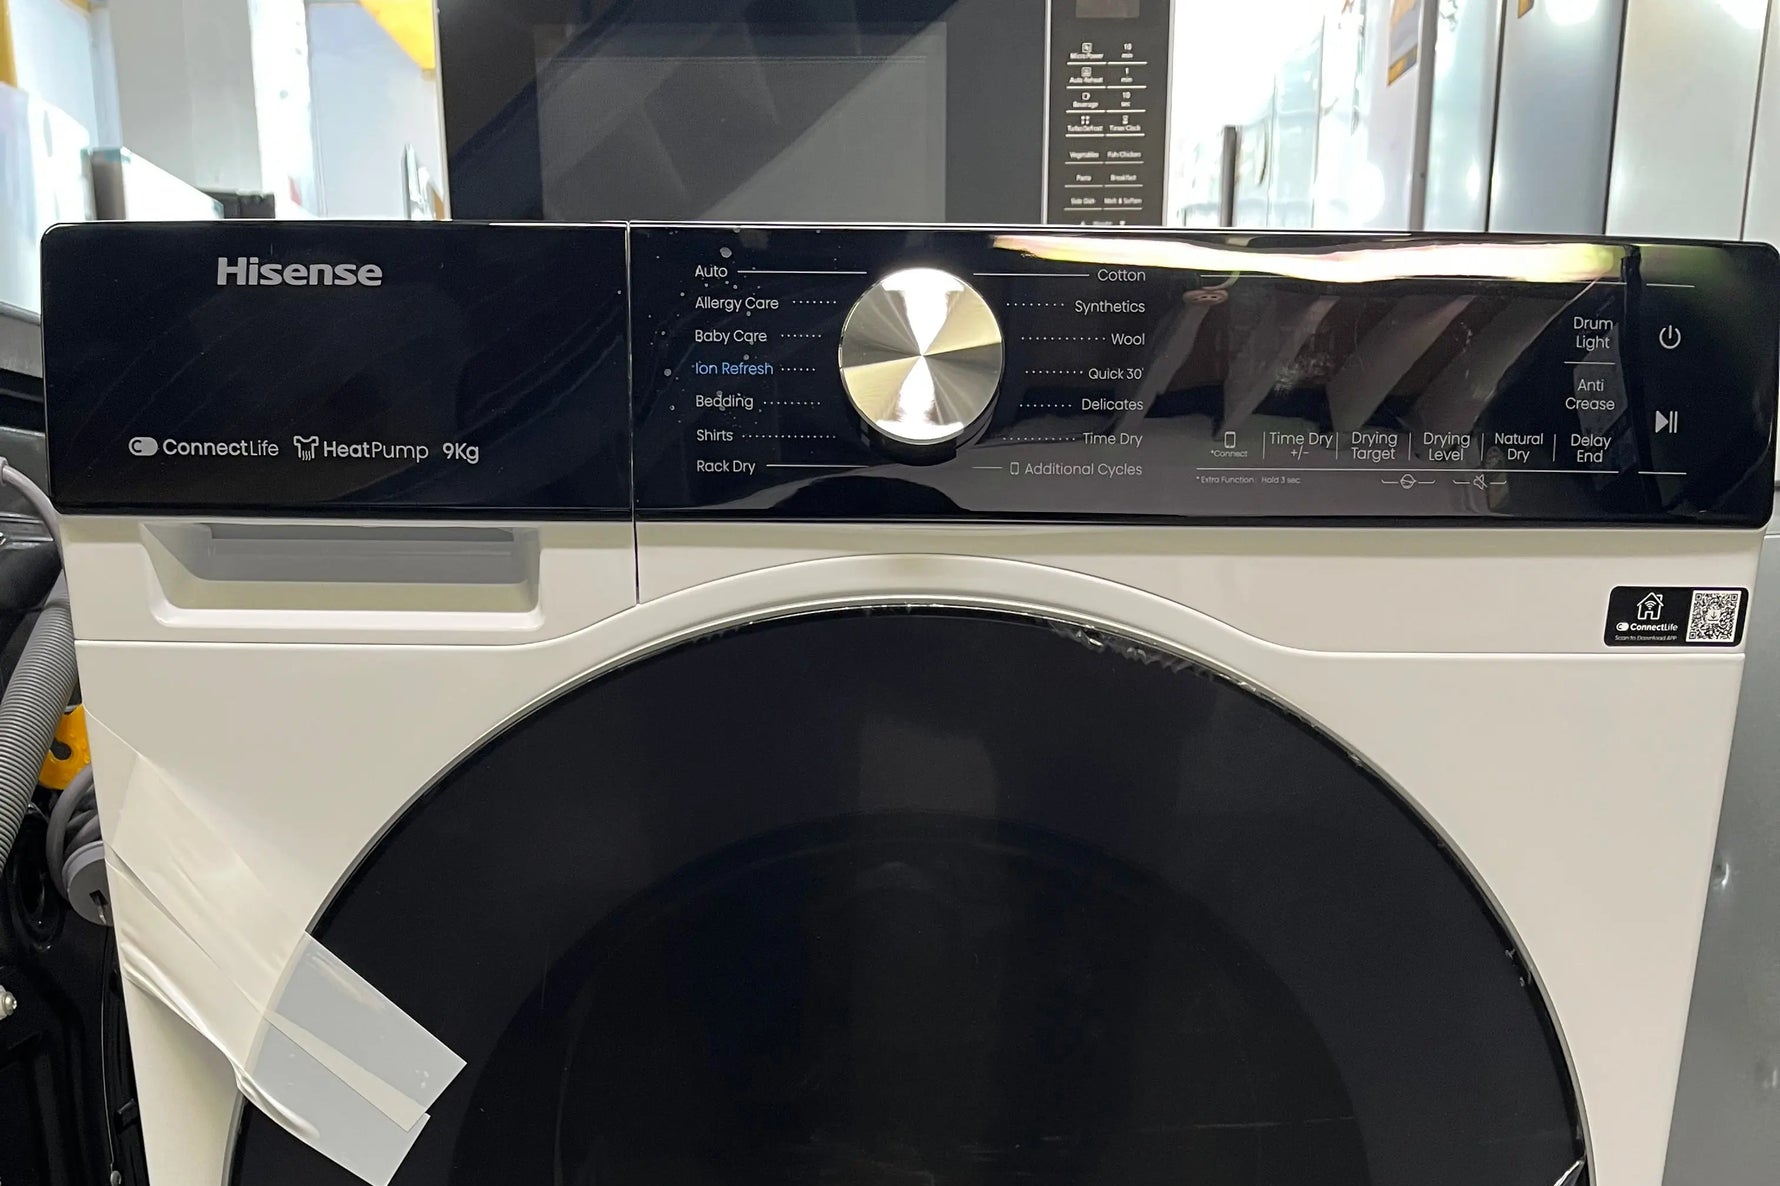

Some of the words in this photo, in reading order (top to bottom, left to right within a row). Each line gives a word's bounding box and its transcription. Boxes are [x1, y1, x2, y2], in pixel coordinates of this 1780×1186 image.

[216, 257, 383, 287] Hisense
[695, 265, 728, 278] Auto
[1097, 269, 1146, 282] Cotton
[695, 297, 743, 312] Allergy
[745, 297, 779, 310] Care
[1075, 300, 1146, 315] Synthetics
[1573, 316, 1613, 330] Drum
[695, 330, 731, 345] Baby
[733, 330, 767, 342] Care
[1111, 333, 1145, 345] Wool
[1576, 335, 1610, 351] Light
[695, 362, 718, 375] Ion
[722, 362, 774, 375] Refresh
[1088, 368, 1124, 380] Quick
[1577, 379, 1604, 391] Anti
[695, 394, 754, 410] Bedding
[1081, 398, 1144, 411] Delicates
[1565, 398, 1615, 411] Crease
[696, 429, 733, 442] Shirts
[1083, 432, 1116, 445] Time
[1120, 433, 1143, 448] Dry
[1269, 432, 1305, 445] Time
[1309, 433, 1333, 447] Dry
[1352, 432, 1398, 447] Drying
[1423, 432, 1471, 448] Drying
[1495, 433, 1544, 446] Natural
[1571, 434, 1611, 449] Delay
[163, 438, 280, 457] ConnectLife
[323, 440, 430, 462] HeatPump
[442, 443, 480, 464] 9Kg
[1351, 447, 1396, 462] Target
[1429, 448, 1464, 461] Level
[1508, 449, 1530, 463] Dry
[1576, 450, 1603, 463] End
[697, 460, 731, 472] Rack
[733, 460, 756, 475] Dry
[1024, 463, 1094, 475] Additional
[1097, 463, 1143, 478] Cycles
[1261, 476, 1279, 484] Hold
[1630, 623, 1679, 631] ConnectLife
